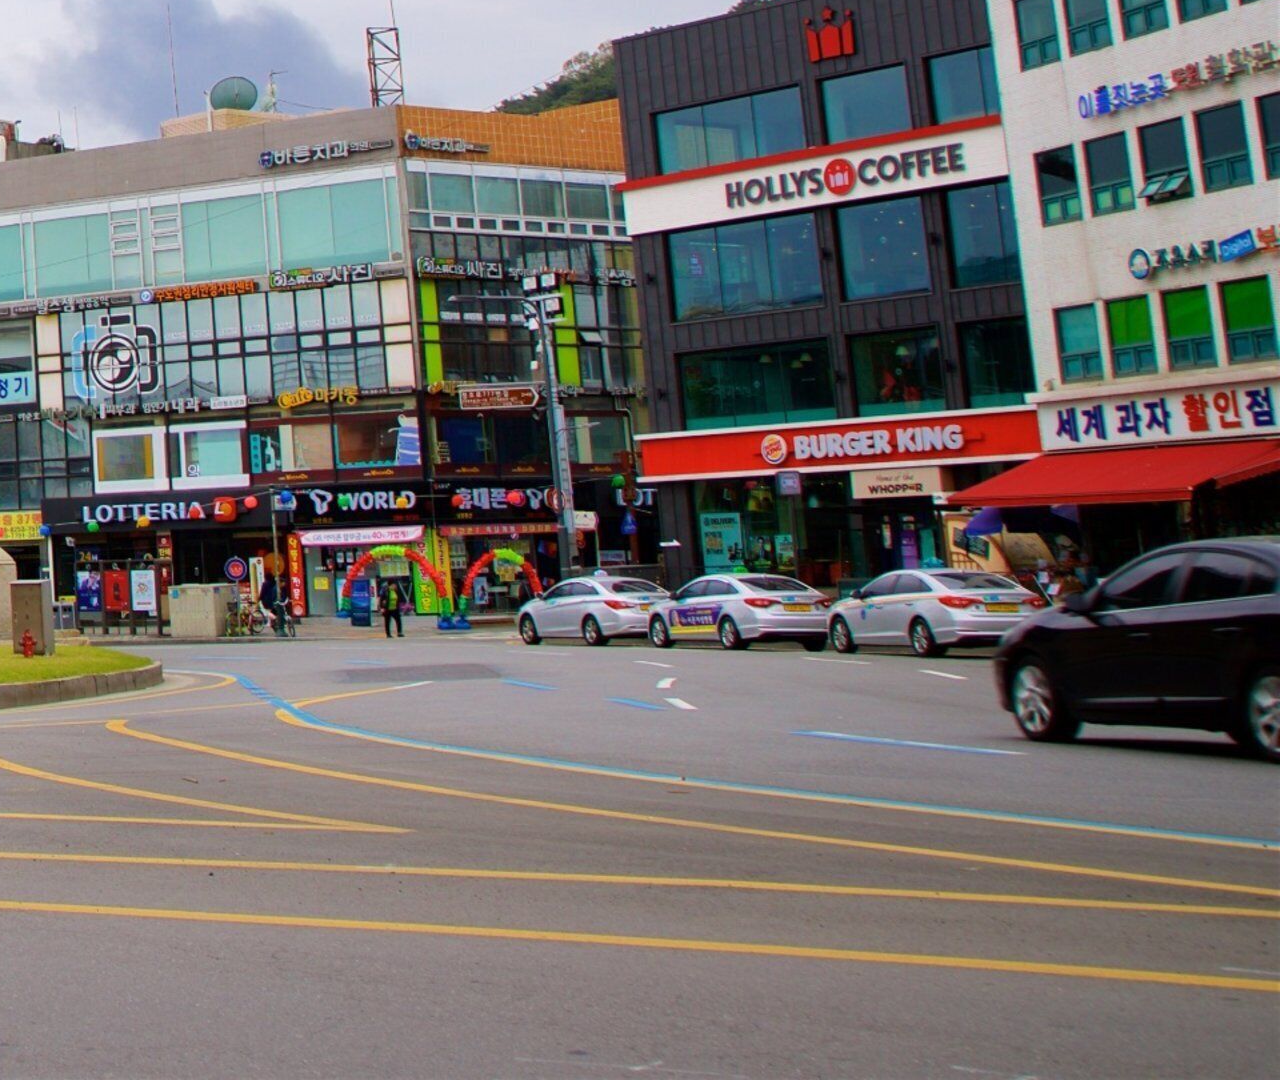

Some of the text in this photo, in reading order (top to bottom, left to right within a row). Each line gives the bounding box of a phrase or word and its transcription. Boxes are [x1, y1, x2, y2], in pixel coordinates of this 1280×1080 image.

[273, 140, 348, 165] 바른치과
[420, 137, 467, 153] 바른치과
[724, 143, 966, 208] HOLLYS COFFEE
[287, 273, 326, 286] 스튜디오
[328, 263, 373, 282] 사진
[467, 261, 503, 279] 사진
[172, 397, 200, 413] 내과
[278, 386, 314, 409] Cafe
[315, 385, 360, 406] 마카롱
[1056, 387, 1276, 442] 세계 과자 할인점
[793, 424, 964, 459] BURGER KING
[456, 487, 507, 510] 휴대폰
[82, 501, 206, 523] LOTTERIA
